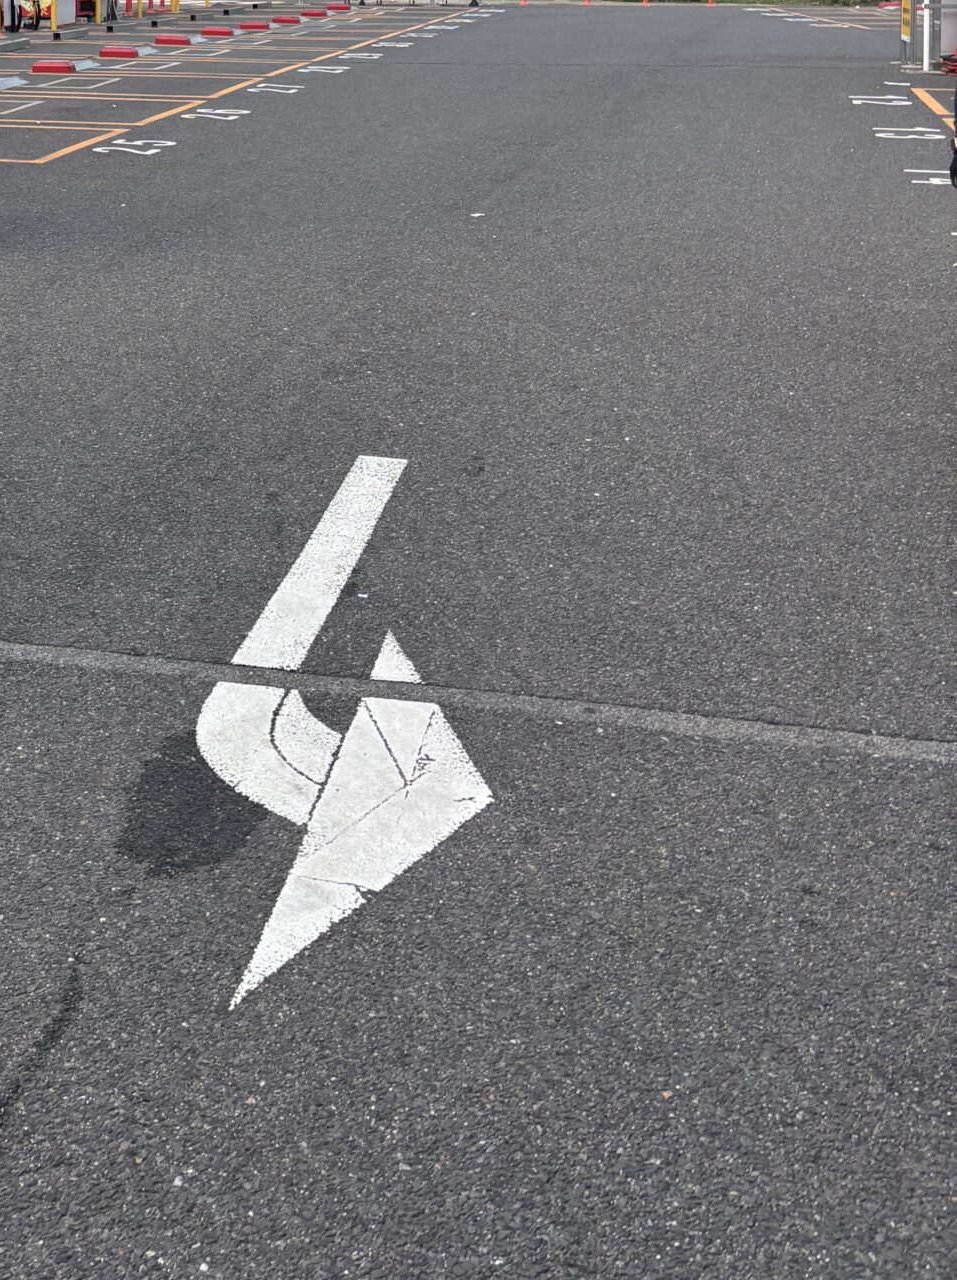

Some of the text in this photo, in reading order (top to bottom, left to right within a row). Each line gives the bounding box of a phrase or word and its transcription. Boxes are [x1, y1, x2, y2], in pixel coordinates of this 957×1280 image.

[247, 83, 305, 93] 27
[181, 108, 251, 120] 26
[872, 127, 946, 140] 13
[92, 139, 177, 155] 25
